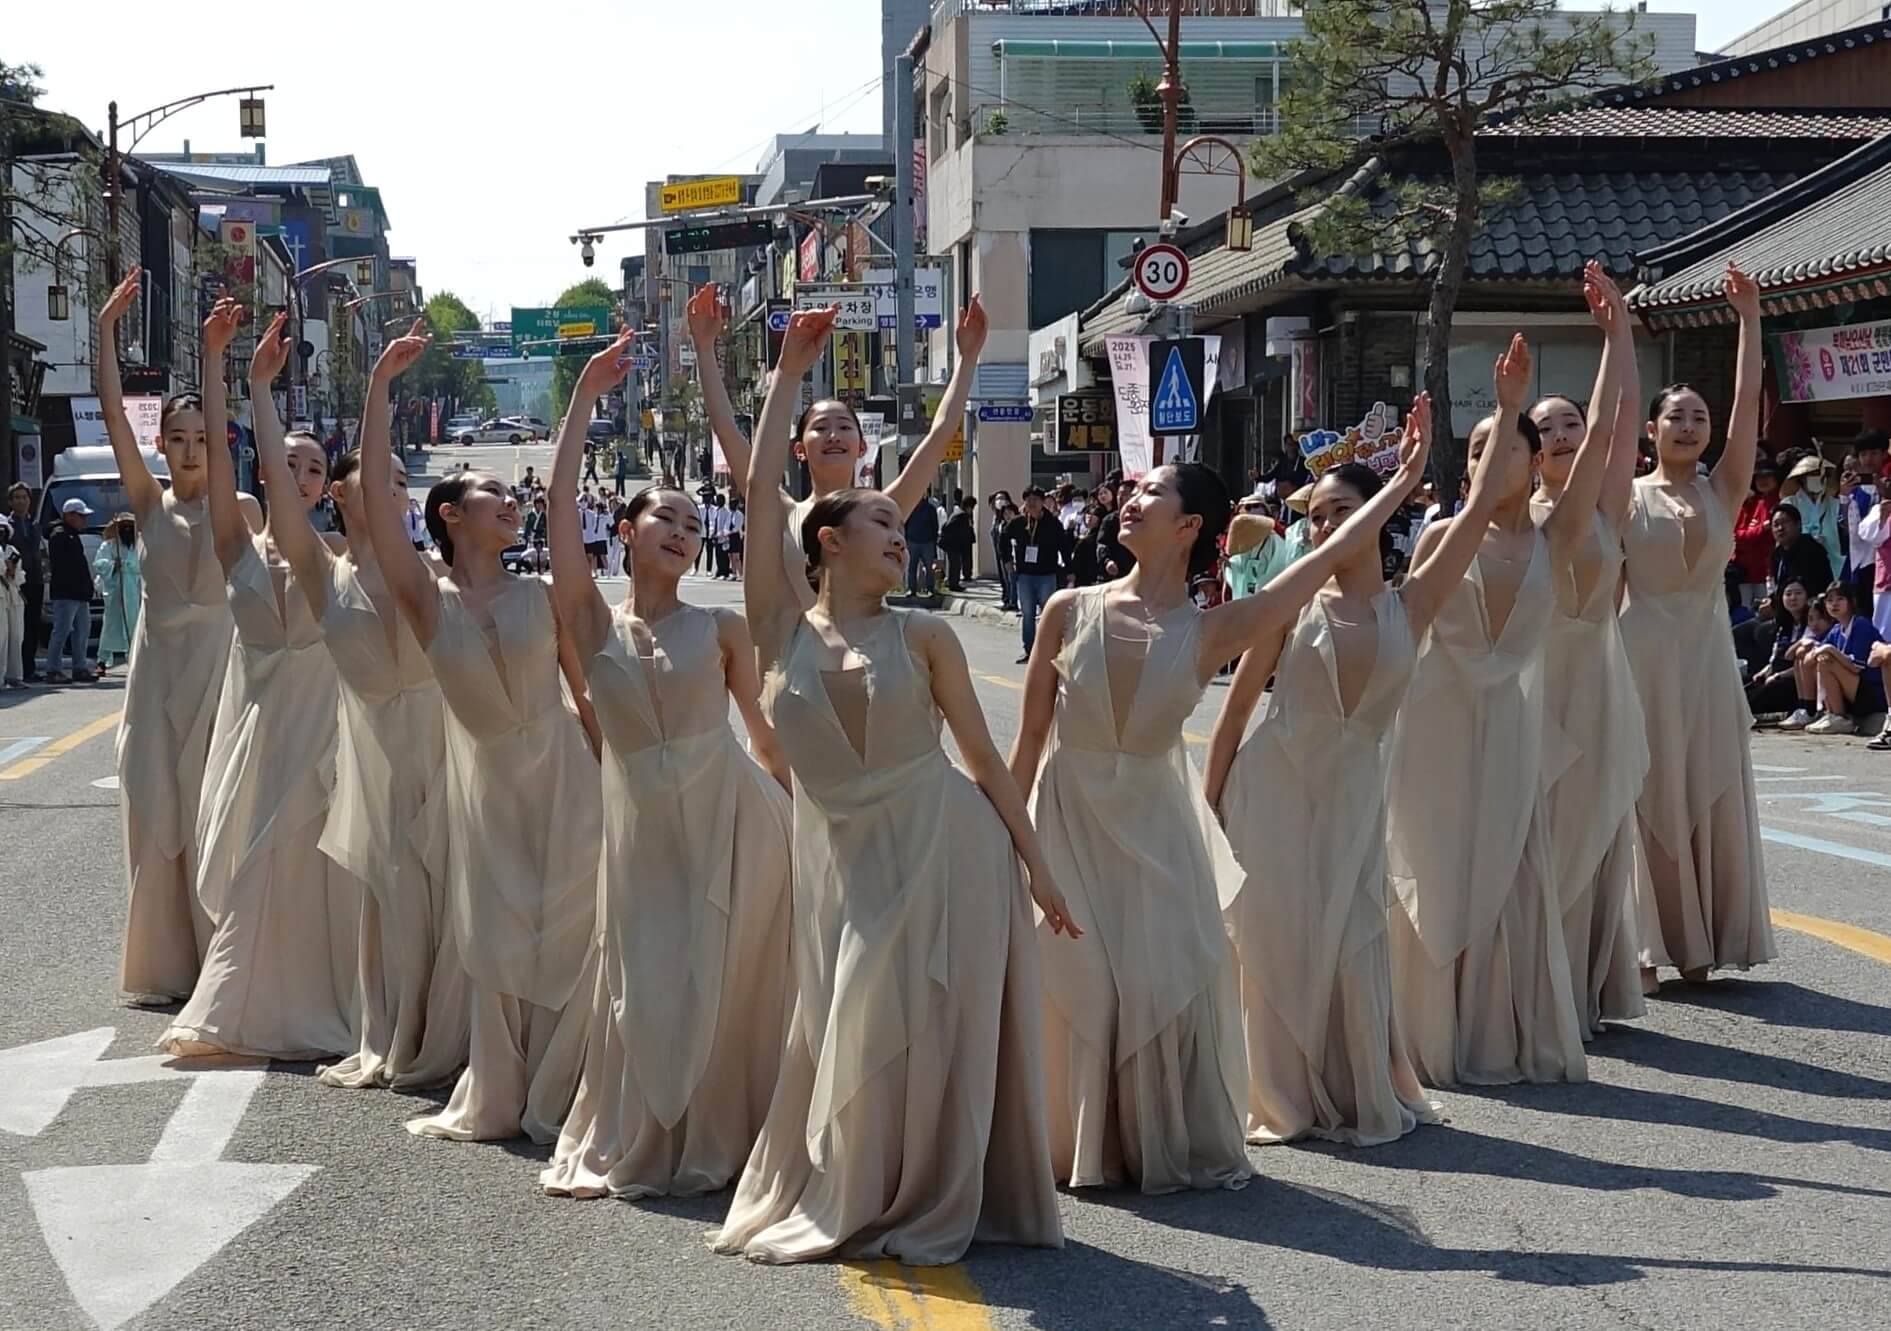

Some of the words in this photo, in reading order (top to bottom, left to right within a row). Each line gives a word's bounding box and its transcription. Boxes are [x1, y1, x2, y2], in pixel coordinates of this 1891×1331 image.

[1146, 261, 1178, 284] 30
[837, 317, 873, 326] Parking
[1112, 342, 1136, 352] 2025
[1159, 411, 1193, 424] 횡단보도
[1067, 425, 1110, 448] 세탁
